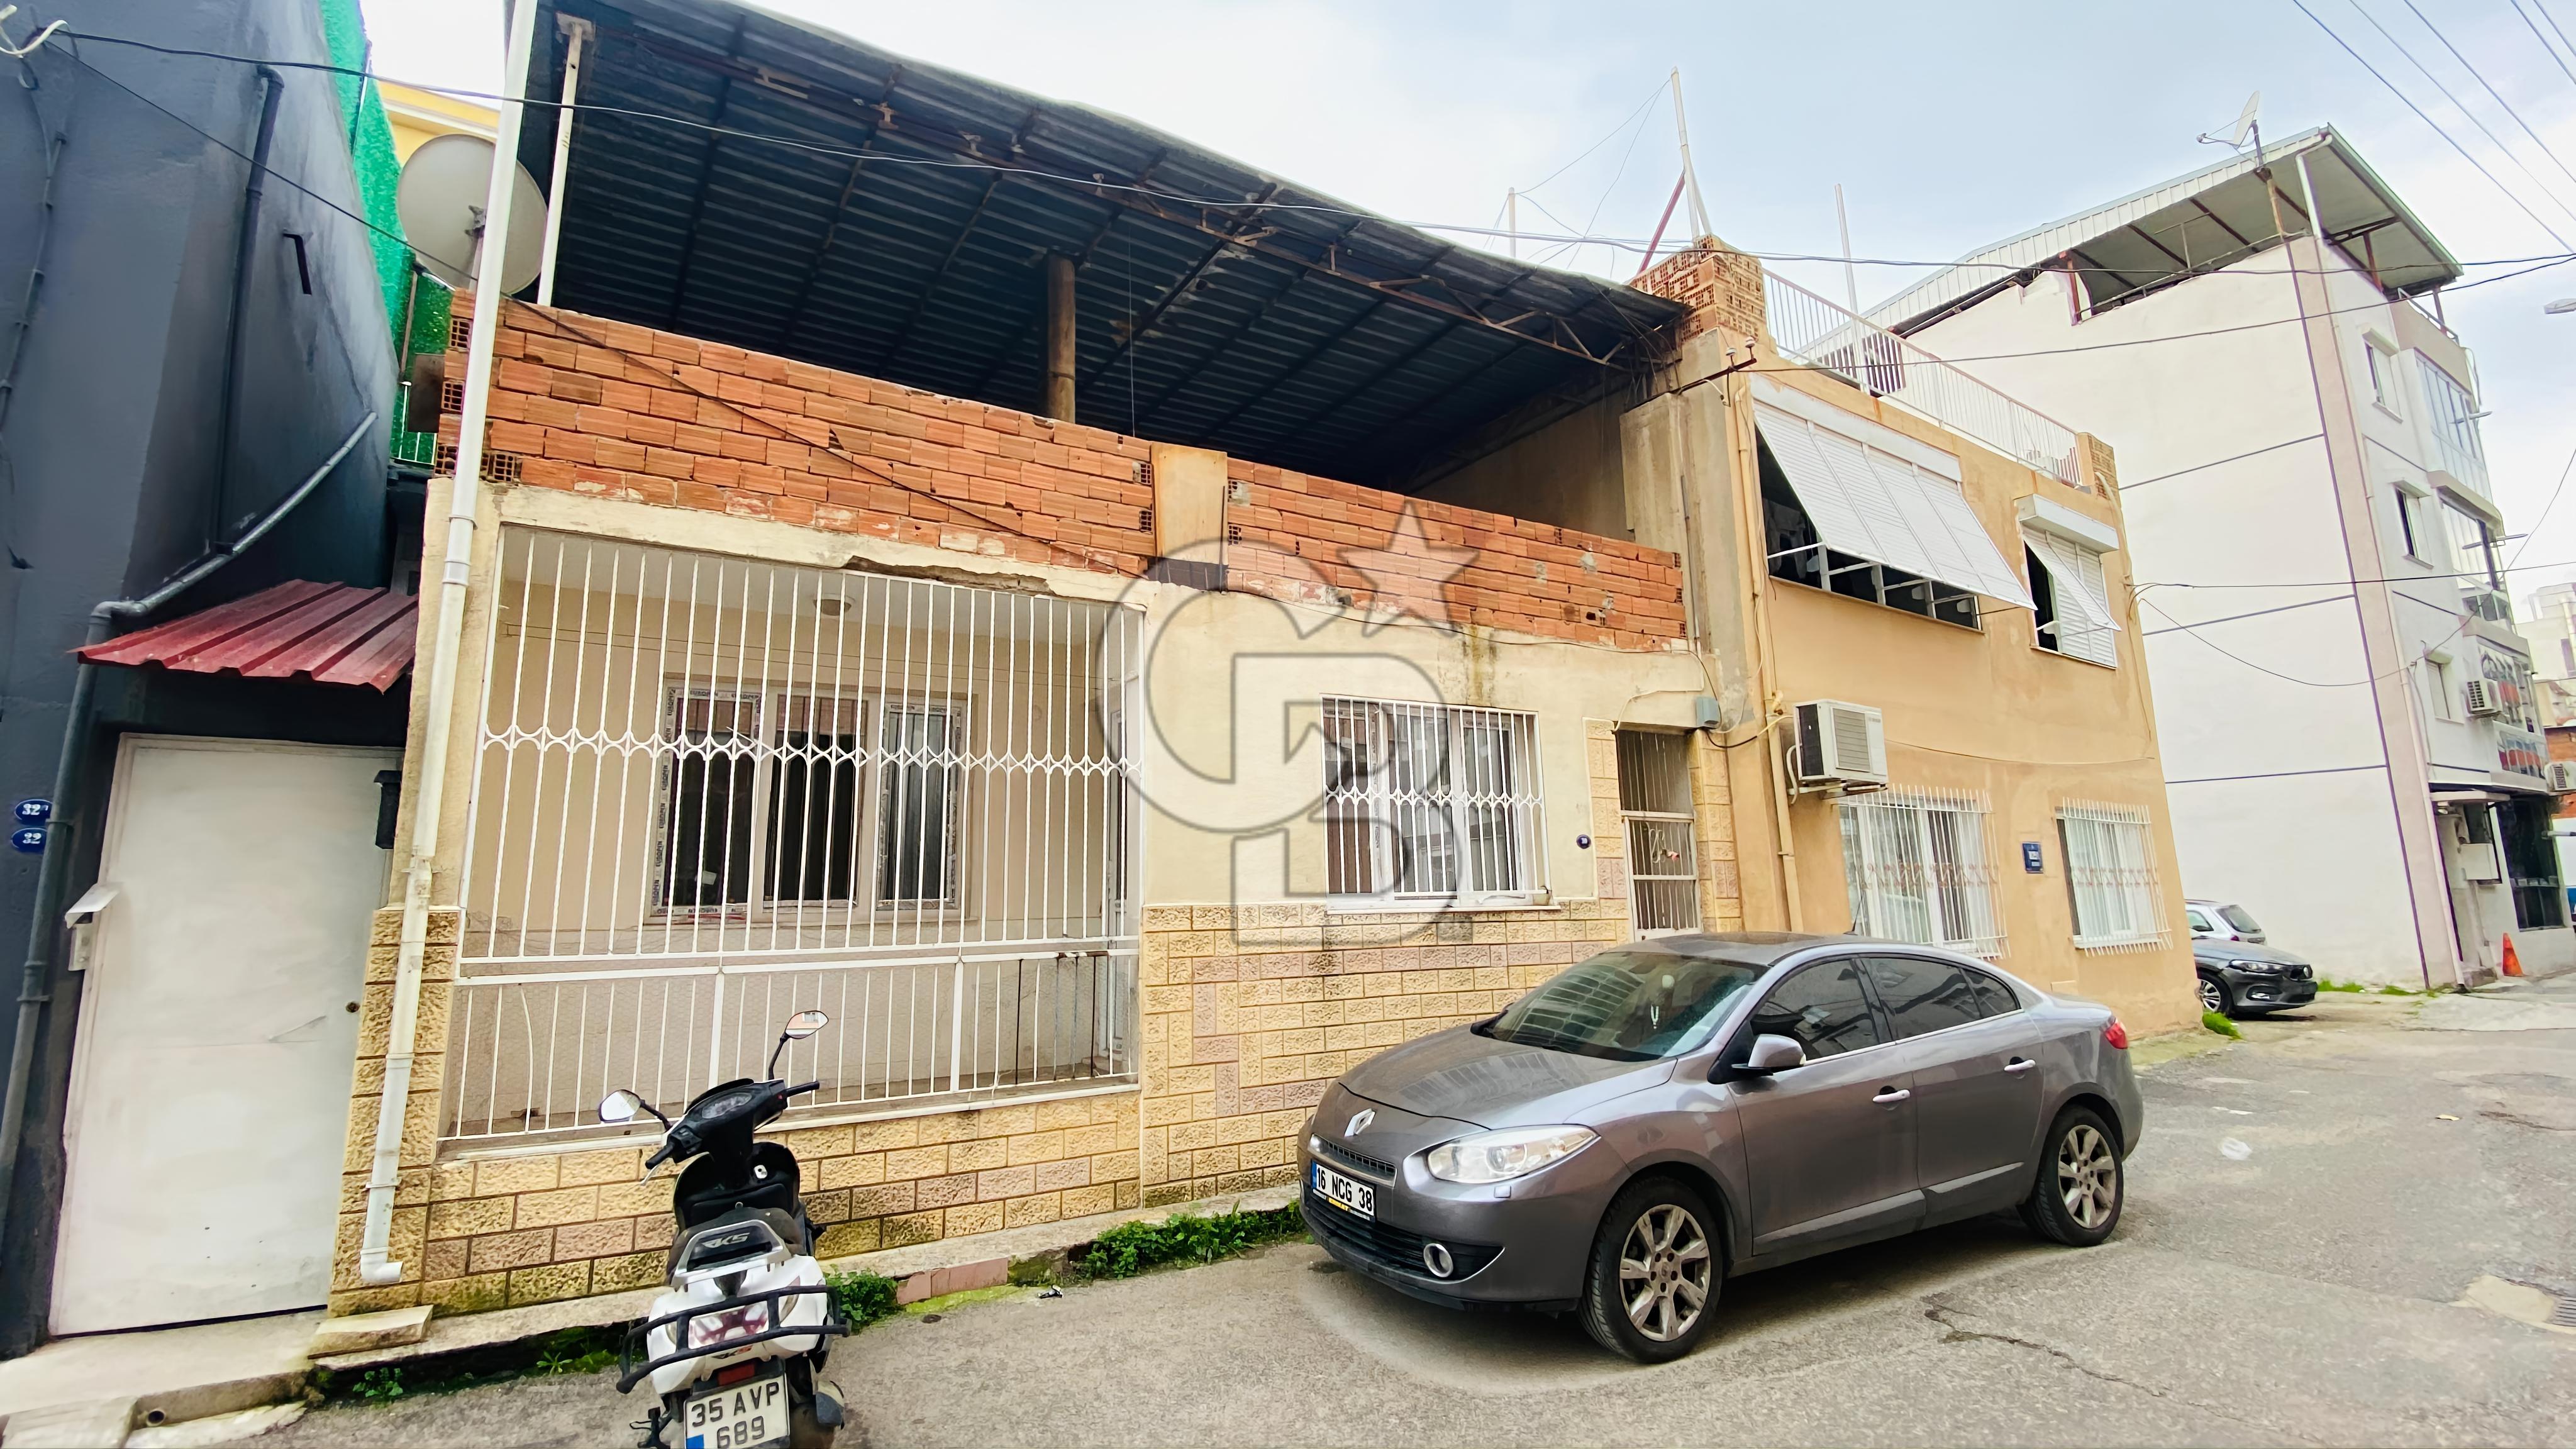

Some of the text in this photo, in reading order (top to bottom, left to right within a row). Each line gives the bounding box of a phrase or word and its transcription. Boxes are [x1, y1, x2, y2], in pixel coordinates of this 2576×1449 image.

[23, 832, 42, 844] 32
[1318, 1167, 1372, 1212] 16 NCG 38
[691, 1381, 780, 1428] 35 AVP
[716, 1415, 765, 1449] 689
